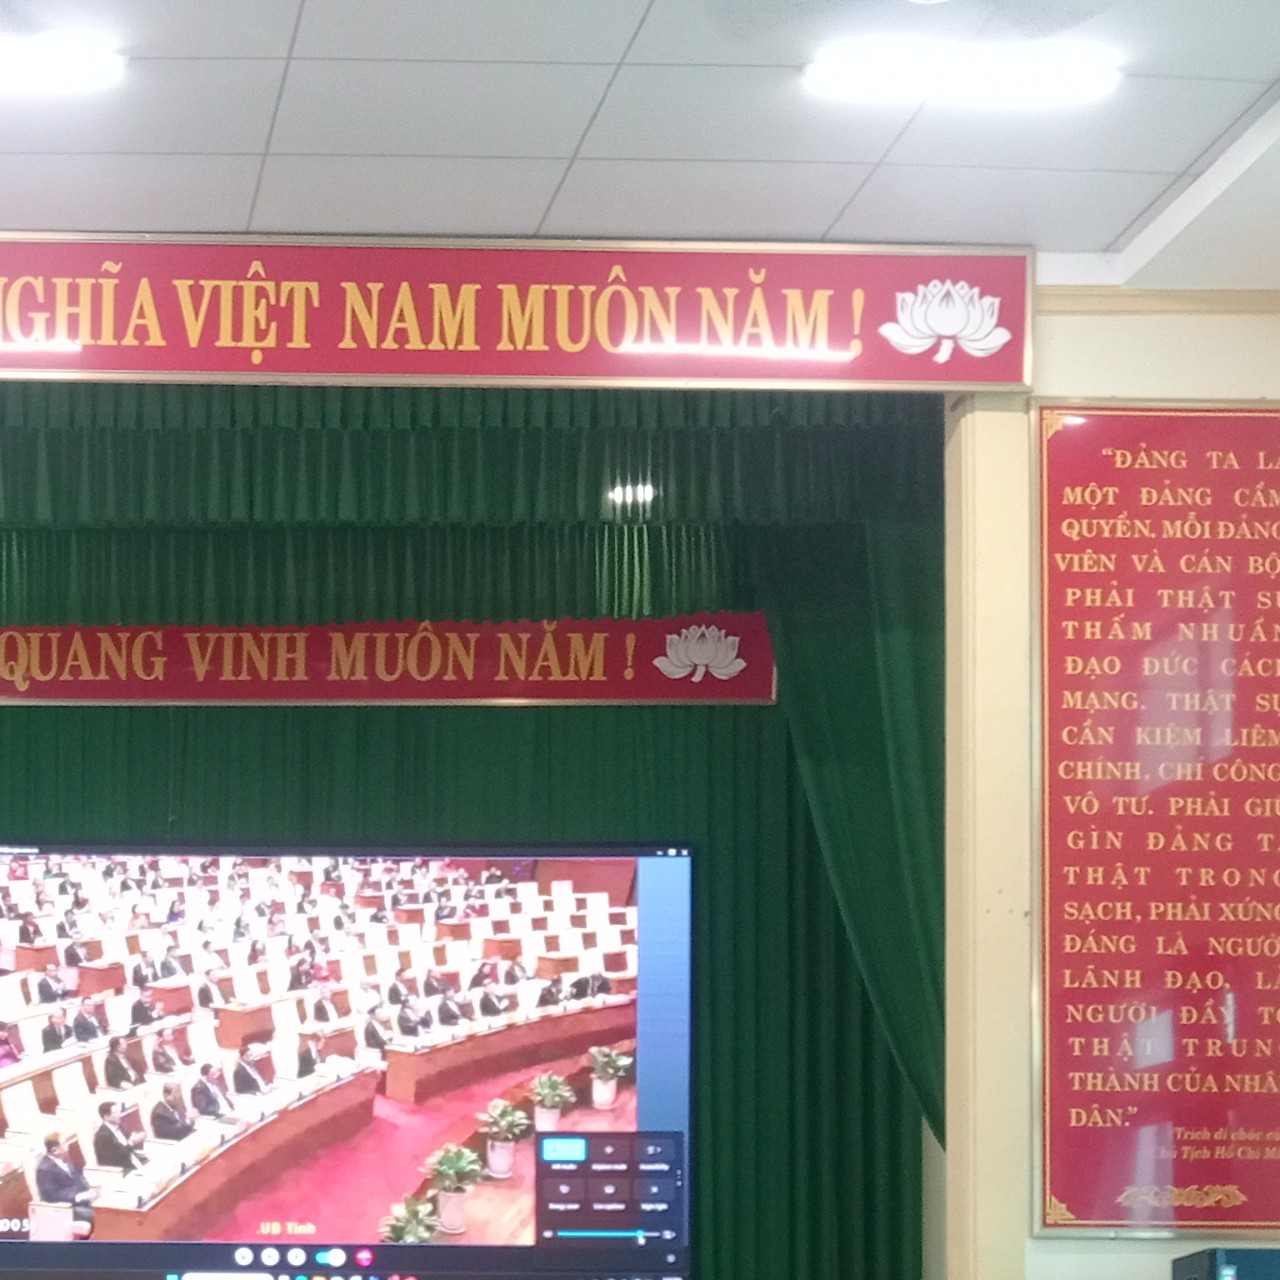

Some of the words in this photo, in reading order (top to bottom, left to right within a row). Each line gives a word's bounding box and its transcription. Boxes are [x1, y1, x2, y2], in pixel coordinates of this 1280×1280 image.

[172, 260, 320, 365] VIỆT
[340, 281, 481, 351] NAM
[496, 265, 681, 353] MUÔN
[696, 267, 835, 357] NĂM
[1207, 451, 1240, 470] TA
[1062, 482, 1119, 510] MỘT
[1140, 480, 1213, 506] ĐẢNG
[1162, 511, 1212, 539] MỖI
[1054, 549, 1117, 572] VIÊN
[1132, 549, 1165, 573] VÀ
[1179, 549, 1233, 573] CÁN
[1065, 580, 1135, 607] PHẢI
[1157, 585, 1236, 613] THẬT
[184, 631, 308, 682] VINH
[327, 620, 478, 683] MUÔN
[495, 619, 608, 682] NĂM
[1064, 655, 1121, 680] ĐẠO
[1158, 755, 1203, 781] CHÍ
[1063, 790, 1099, 815] VÔ
[1169, 790, 1230, 816] PHẢI
[1067, 824, 1123, 850] GÌN
[1147, 824, 1234, 851] ĐẢNG
[1064, 862, 1150, 890] THẬT
[1149, 895, 1210, 921] PHẢI
[1064, 928, 1136, 954] ĐÁNG
[1156, 931, 1188, 955] LÀ
[1063, 964, 1142, 989] LÃNH
[1183, 1038, 1280, 1058] TRUN
[1069, 1066, 1160, 1092] THÀNH
[1166, 1066, 1219, 1093] CỦA
